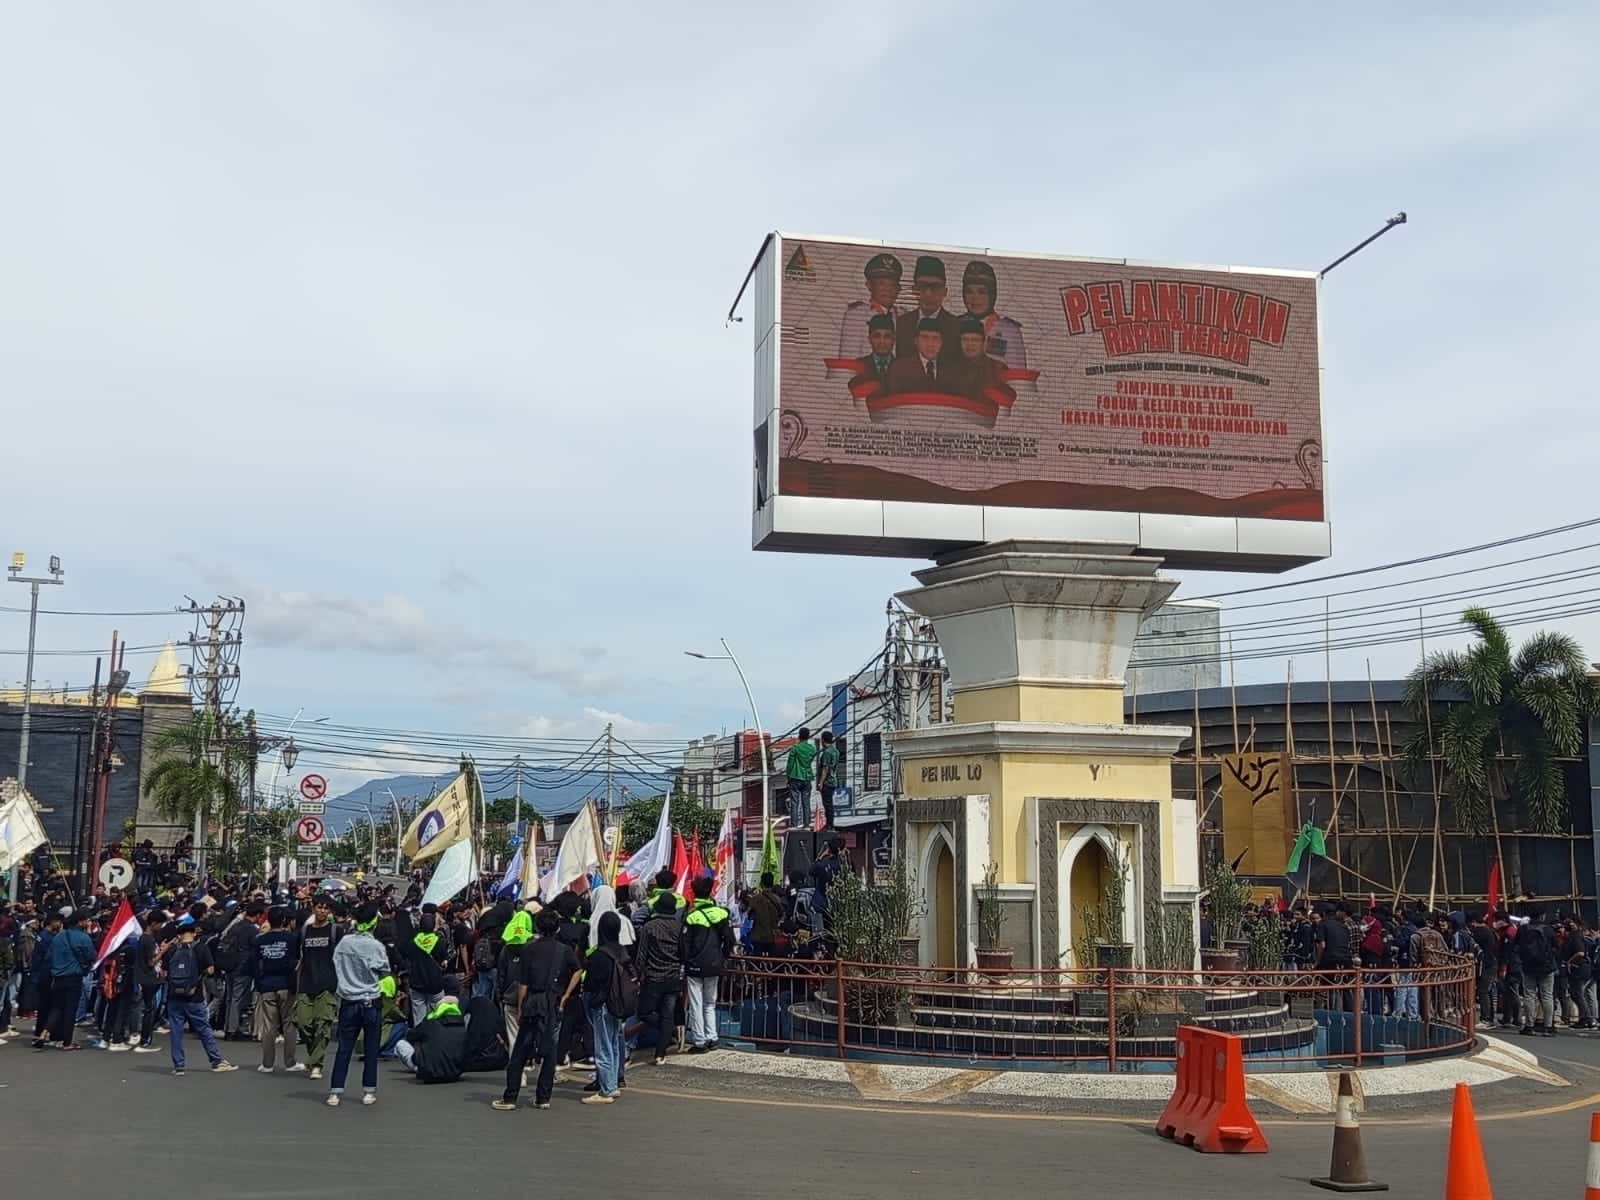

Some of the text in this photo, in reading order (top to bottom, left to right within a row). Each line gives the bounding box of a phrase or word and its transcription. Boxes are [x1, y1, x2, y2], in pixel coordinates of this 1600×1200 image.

[1059, 281, 1291, 347] PELANTIKAN
[1102, 320, 1174, 358] RAPAT
[1179, 322, 1251, 366] KERJA
[1116, 381, 1233, 400] PIMPINAN WILAYAH
[1097, 395, 1253, 417] FORUM KELUARGA ALUMNI
[1061, 410, 1288, 435] IKATAN MAHASISWA MUHAMMADIYAH
[1141, 431, 1211, 447] GORONTALO
